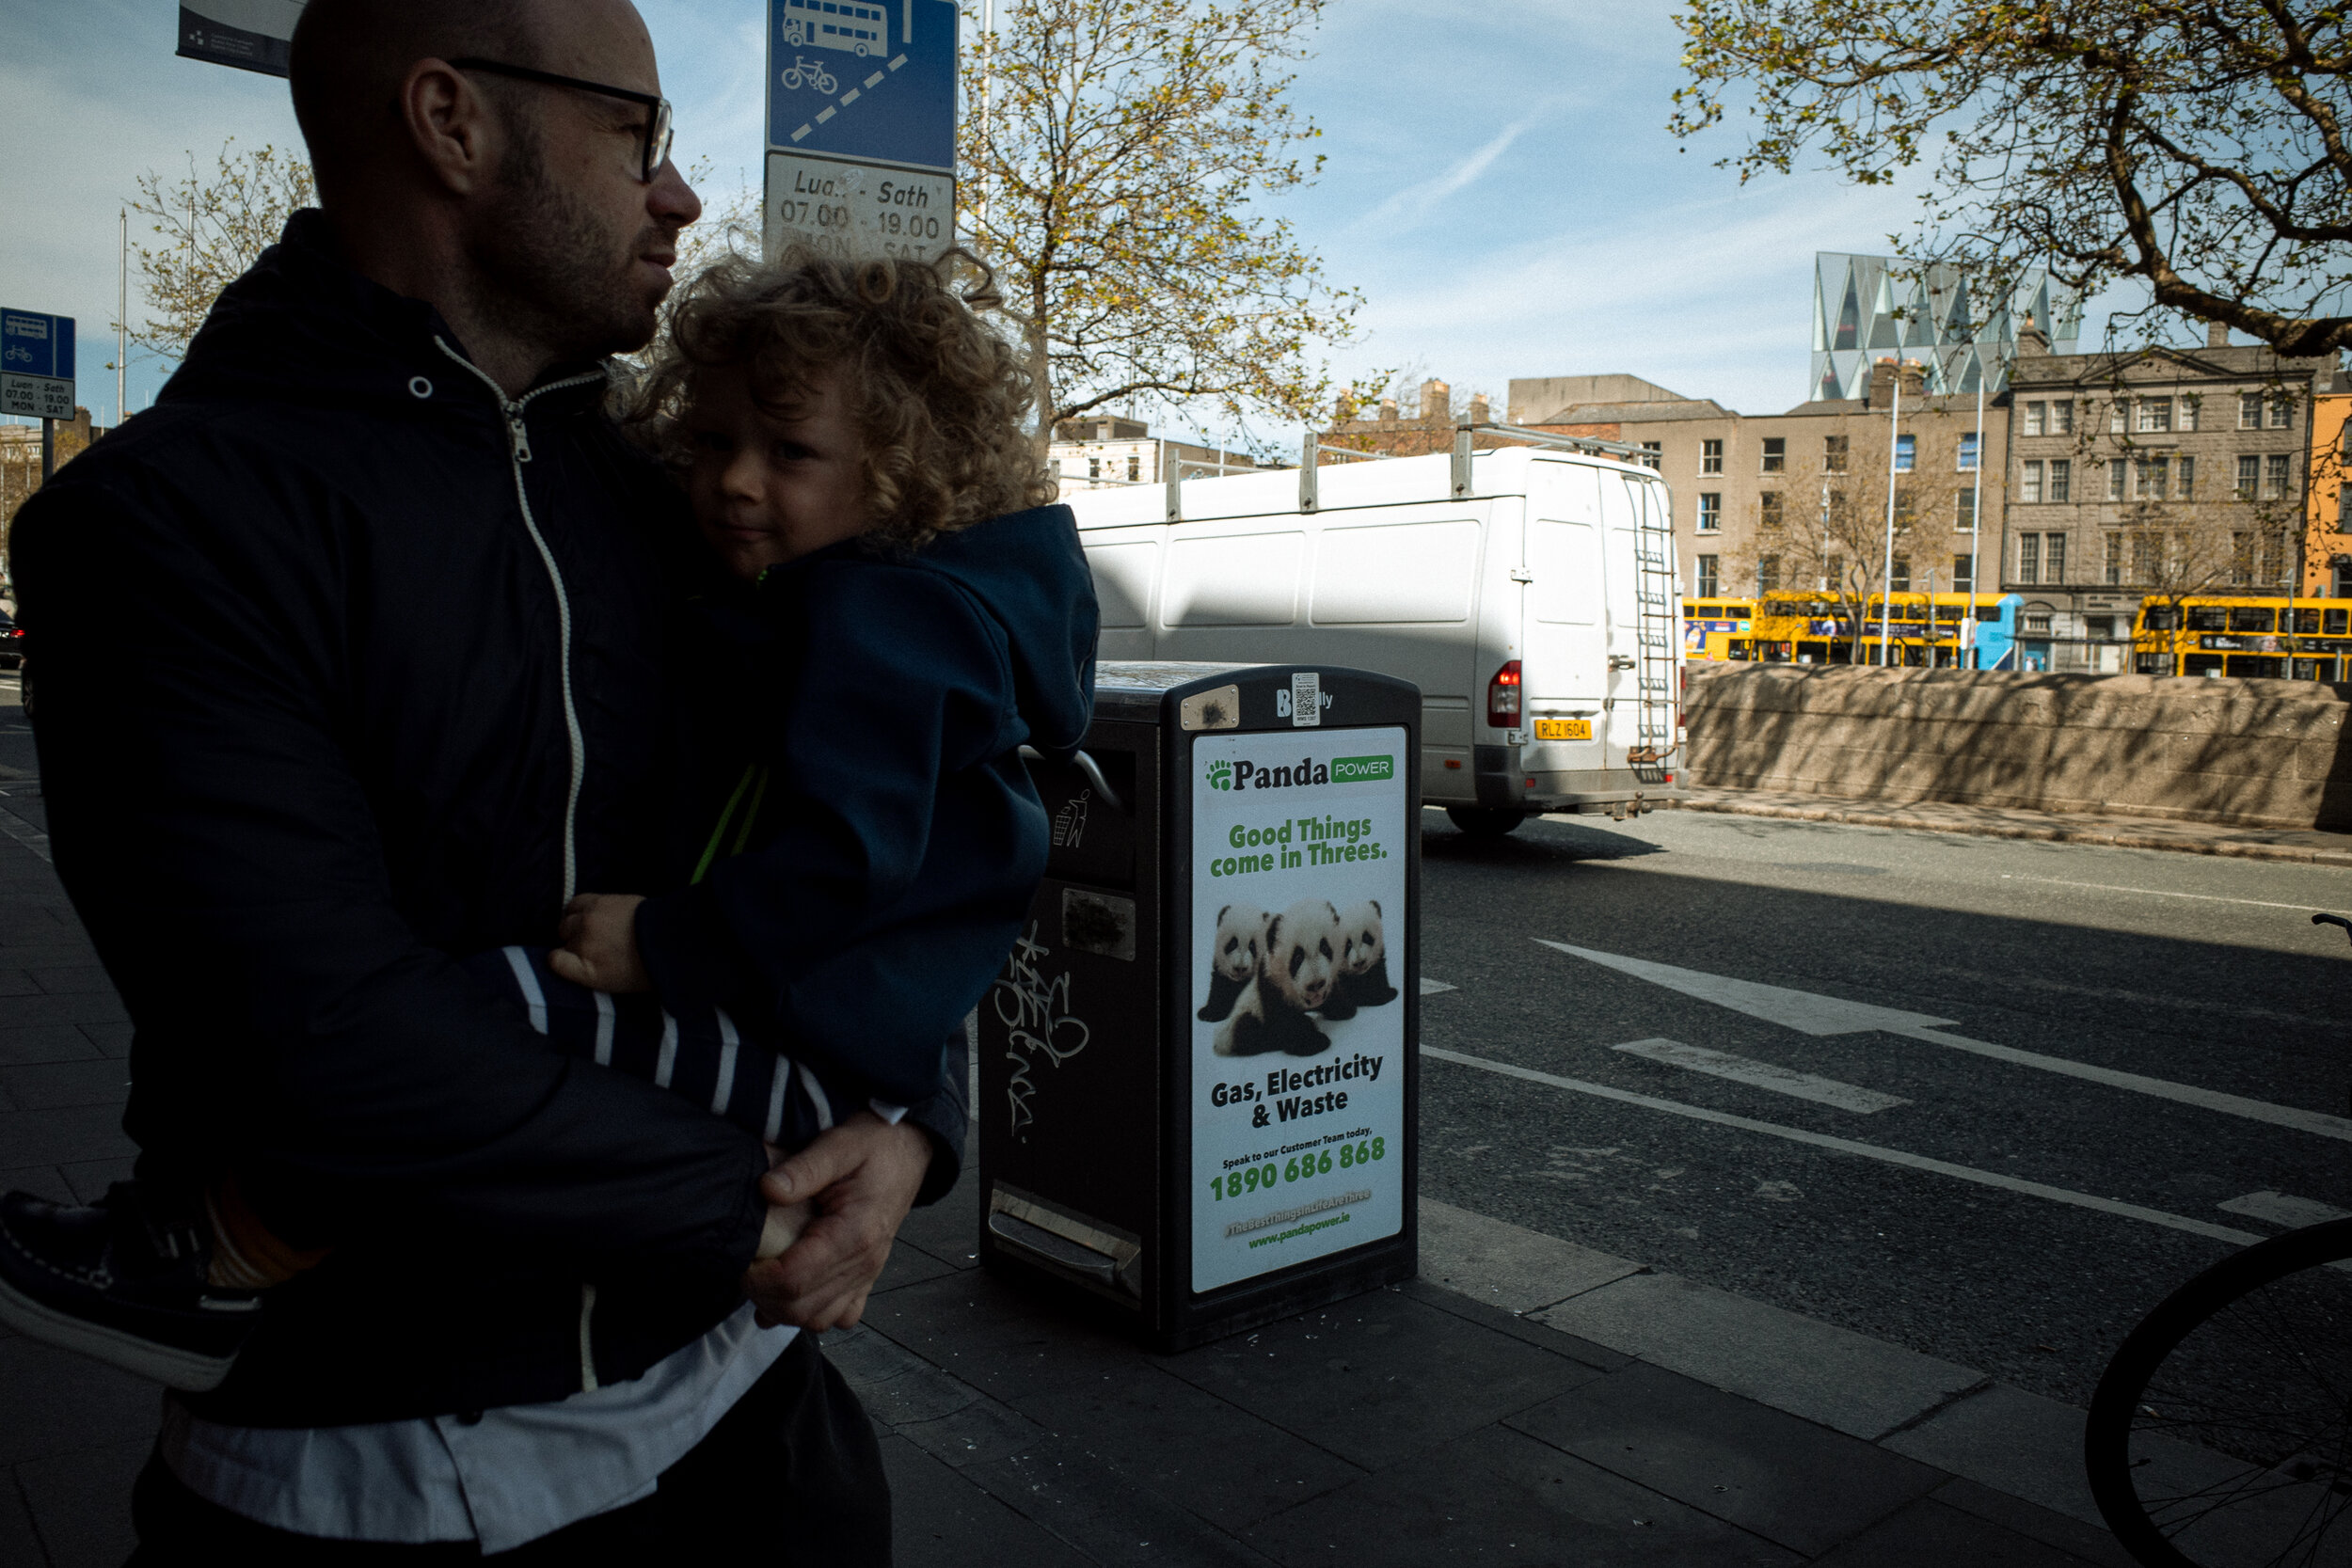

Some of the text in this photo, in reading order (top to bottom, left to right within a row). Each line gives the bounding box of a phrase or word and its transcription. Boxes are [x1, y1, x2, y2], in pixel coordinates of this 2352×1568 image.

[877, 181, 929, 208] Sath
[781, 199, 849, 228] 07.00
[879, 212, 939, 239] 19.00
[6, 389, 34, 401] 07.00
[44, 394, 70, 405] 19.00
[11, 379, 33, 389] Luan
[44, 383, 65, 393] Sath
[11, 401, 35, 411] MON
[45, 404, 65, 414] SAT
[1541, 722, 1586, 736] RLZ 1604
[1233, 757, 1389, 791] Panda POWER
[1229, 815, 1372, 848] Good Things
[1210, 841, 1388, 878] come in Threes.
[1211, 1053, 1383, 1108] Gas, Electricity
[1251, 1091, 1348, 1129] & Waste
[1223, 1127, 1373, 1170] Speak to our Customer Team today,
[1210, 1136, 1386, 1202] 1890 686 868
[1248, 1212, 1351, 1249] www.pandapower.ie
